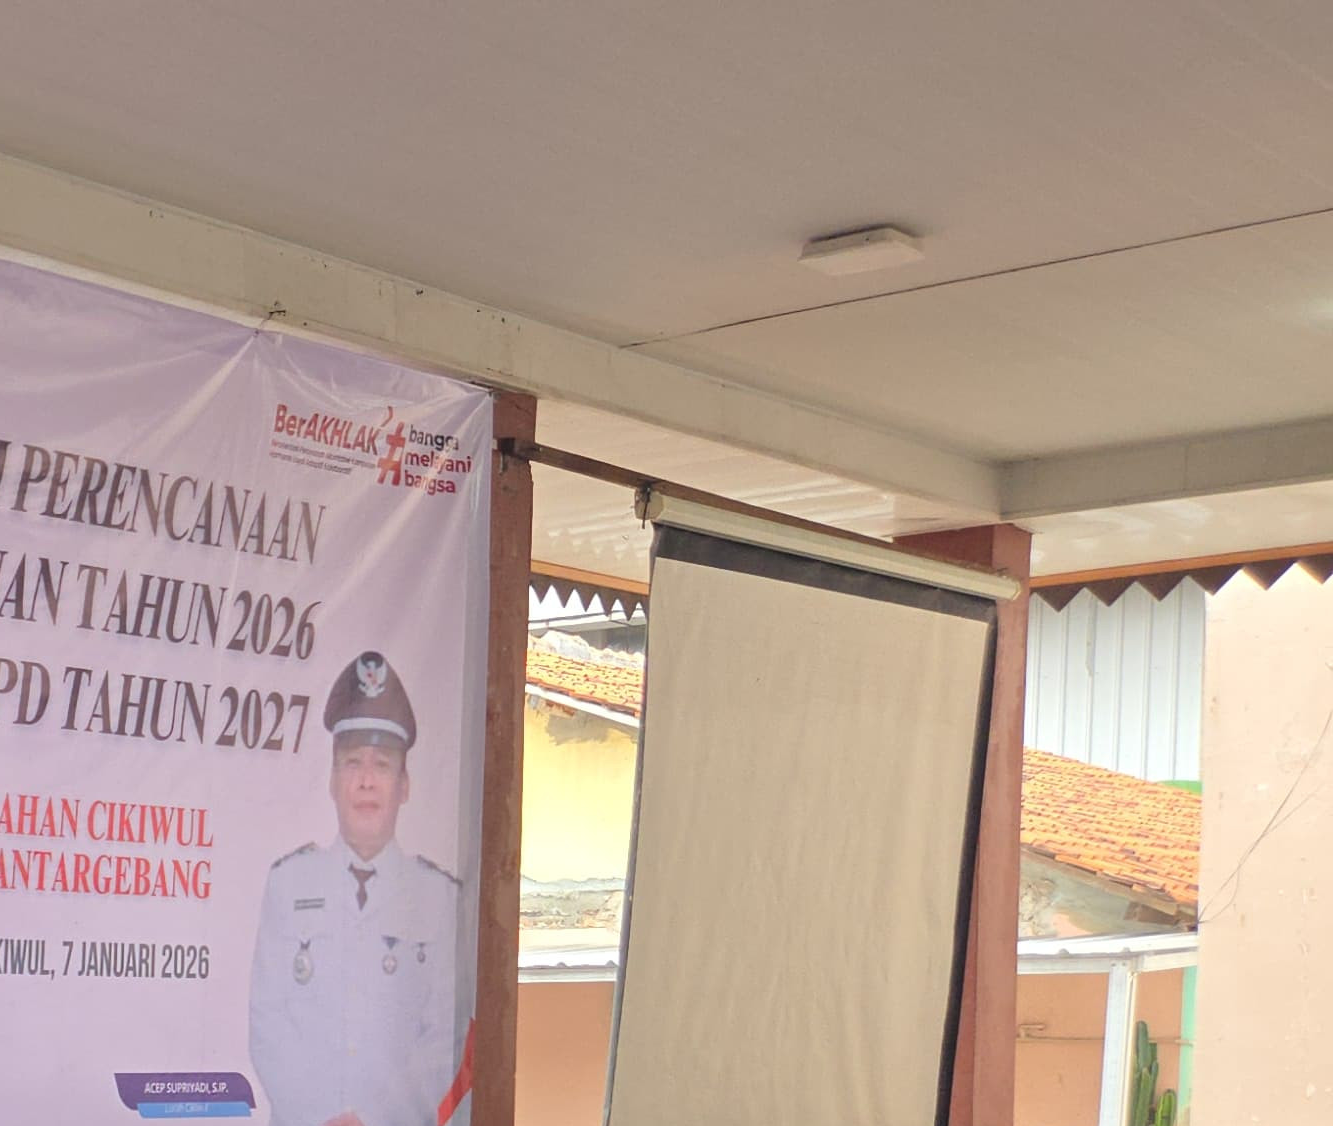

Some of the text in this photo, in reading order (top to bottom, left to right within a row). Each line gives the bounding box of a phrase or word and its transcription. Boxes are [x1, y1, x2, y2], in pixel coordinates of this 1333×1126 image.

[274, 403, 381, 456] BerAKHLAK
[13, 444, 326, 565] PERENCANAAN
[76, 564, 228, 649] TAHUN
[226, 590, 322, 660] 2026
[61, 666, 210, 745] TAHUN
[215, 686, 310, 754] 2027
[86, 799, 214, 848] CIKIWUL
[61, 941, 74, 976] 7
[77, 941, 156, 978] JANUARI
[161, 945, 210, 980] 2026
[144, 1082, 165, 1094] ACEP
